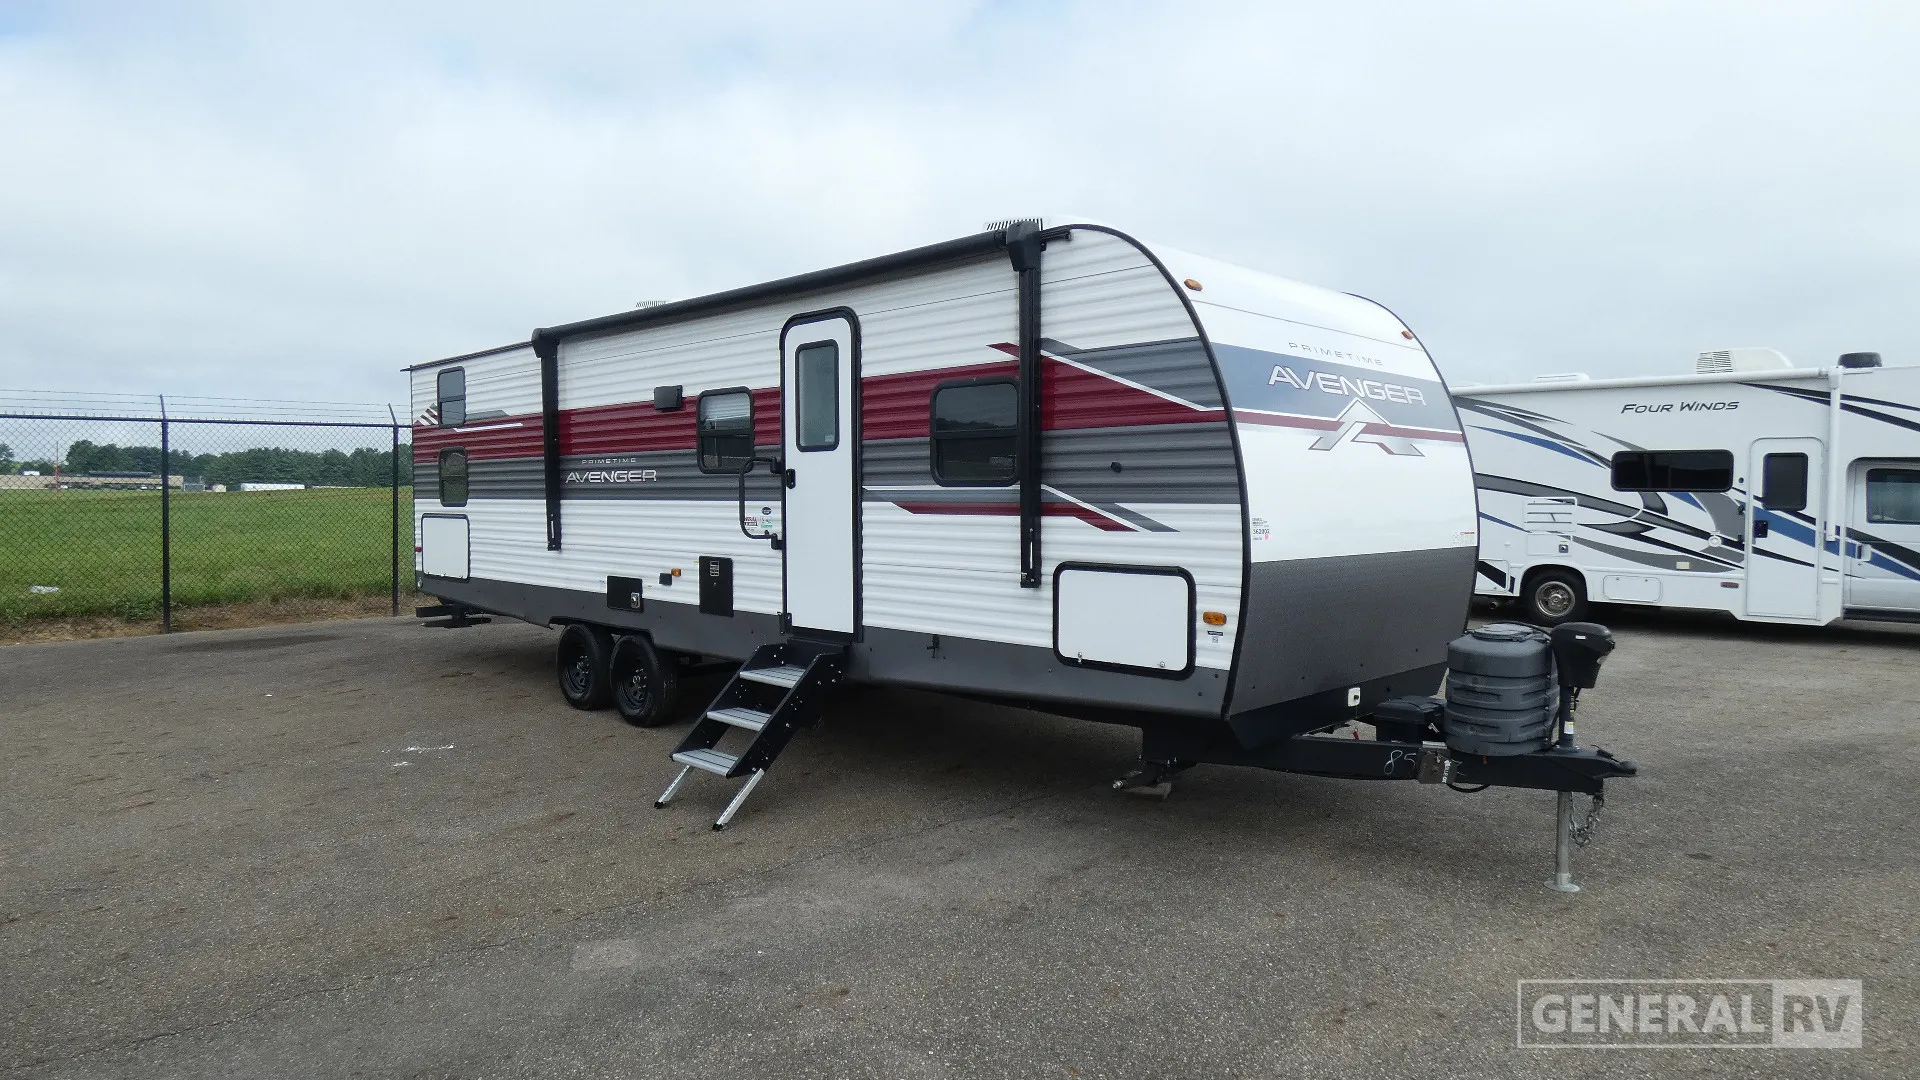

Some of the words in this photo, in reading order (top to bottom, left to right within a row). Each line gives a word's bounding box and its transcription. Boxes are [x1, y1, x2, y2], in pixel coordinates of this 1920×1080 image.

[1288, 342, 1384, 367] PRIMETIME
[1268, 364, 1428, 407] AVENGER
[1620, 403, 1674, 415] FOUR
[1679, 401, 1740, 412] WINDS
[581, 457, 637, 465] PRIMETIME
[565, 469, 657, 484] AVENGER
[1384, 749, 1417, 776] 85
